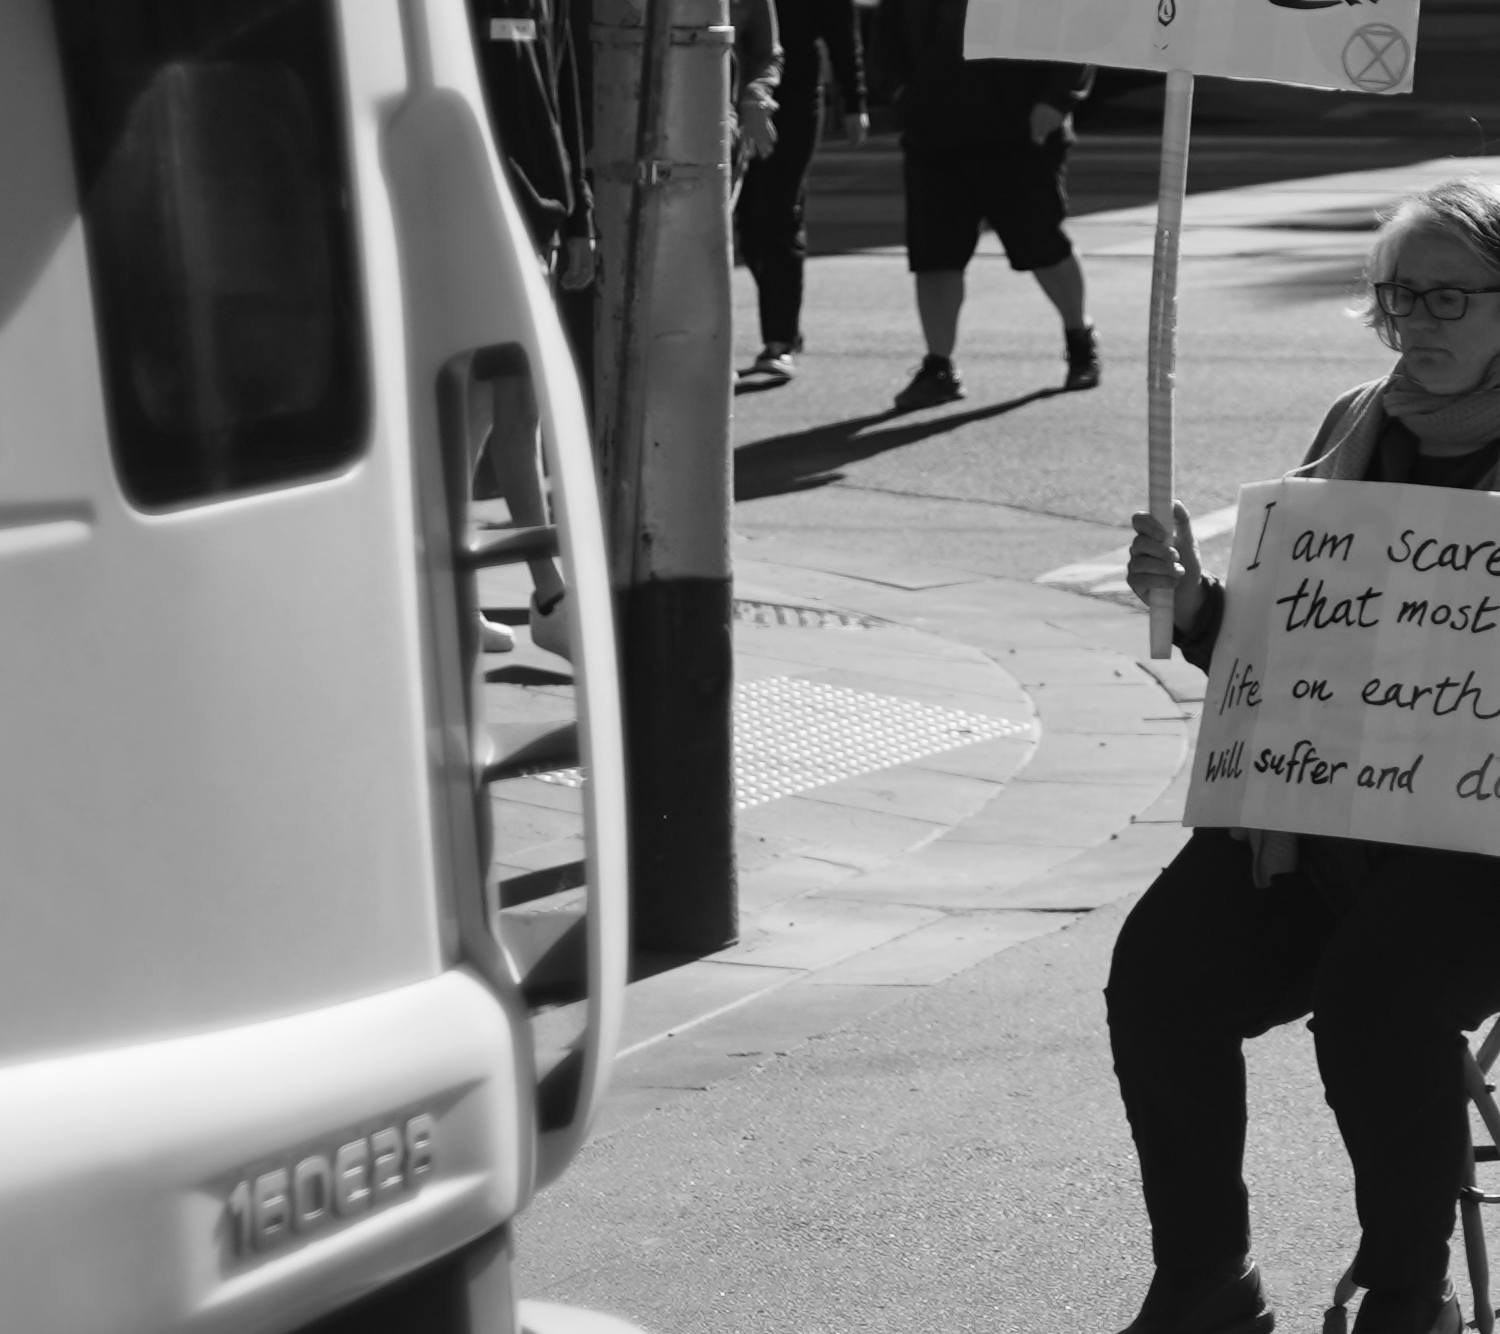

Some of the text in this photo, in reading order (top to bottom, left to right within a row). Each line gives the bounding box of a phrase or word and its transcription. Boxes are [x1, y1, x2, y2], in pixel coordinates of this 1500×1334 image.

[1246, 500, 1277, 571] I
[1291, 528, 1354, 562] am
[1276, 578, 1384, 632] that
[1396, 595, 1500, 634] most
[1219, 657, 1262, 716] life
[1291, 677, 1334, 701] on
[1253, 739, 1348, 786] suffer
[1356, 754, 1425, 795] and
[224, 1113, 437, 1259] 160E28
